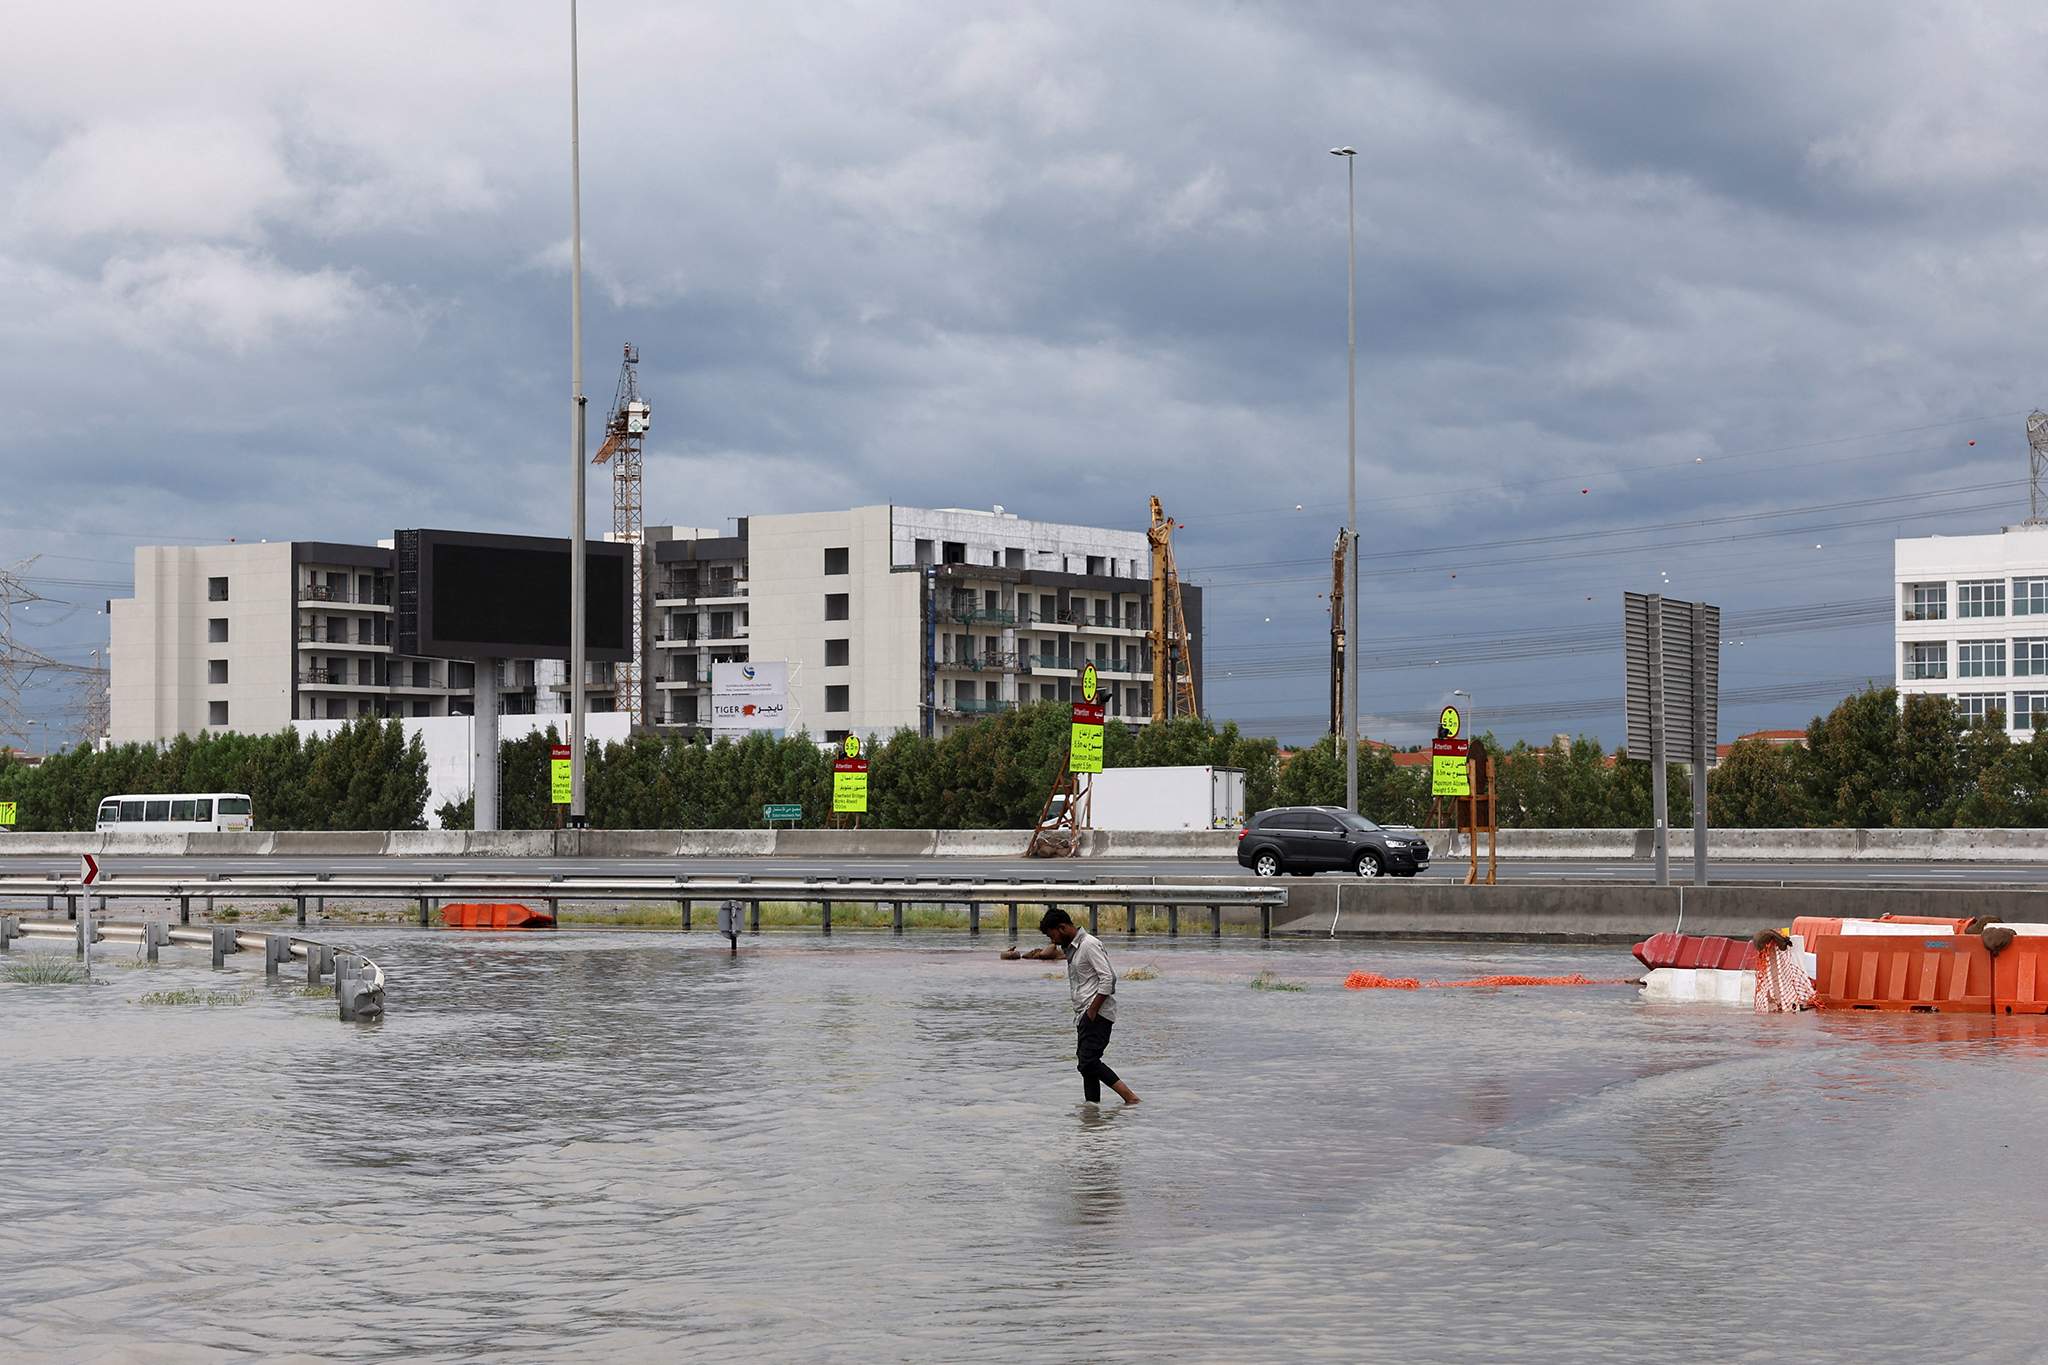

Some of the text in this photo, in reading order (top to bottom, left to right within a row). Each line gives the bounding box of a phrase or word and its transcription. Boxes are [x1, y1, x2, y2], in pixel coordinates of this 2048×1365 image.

[714, 705, 740, 714] TIGER
[1073, 708, 1090, 717] Attention
[1434, 743, 1453, 751] Attention
